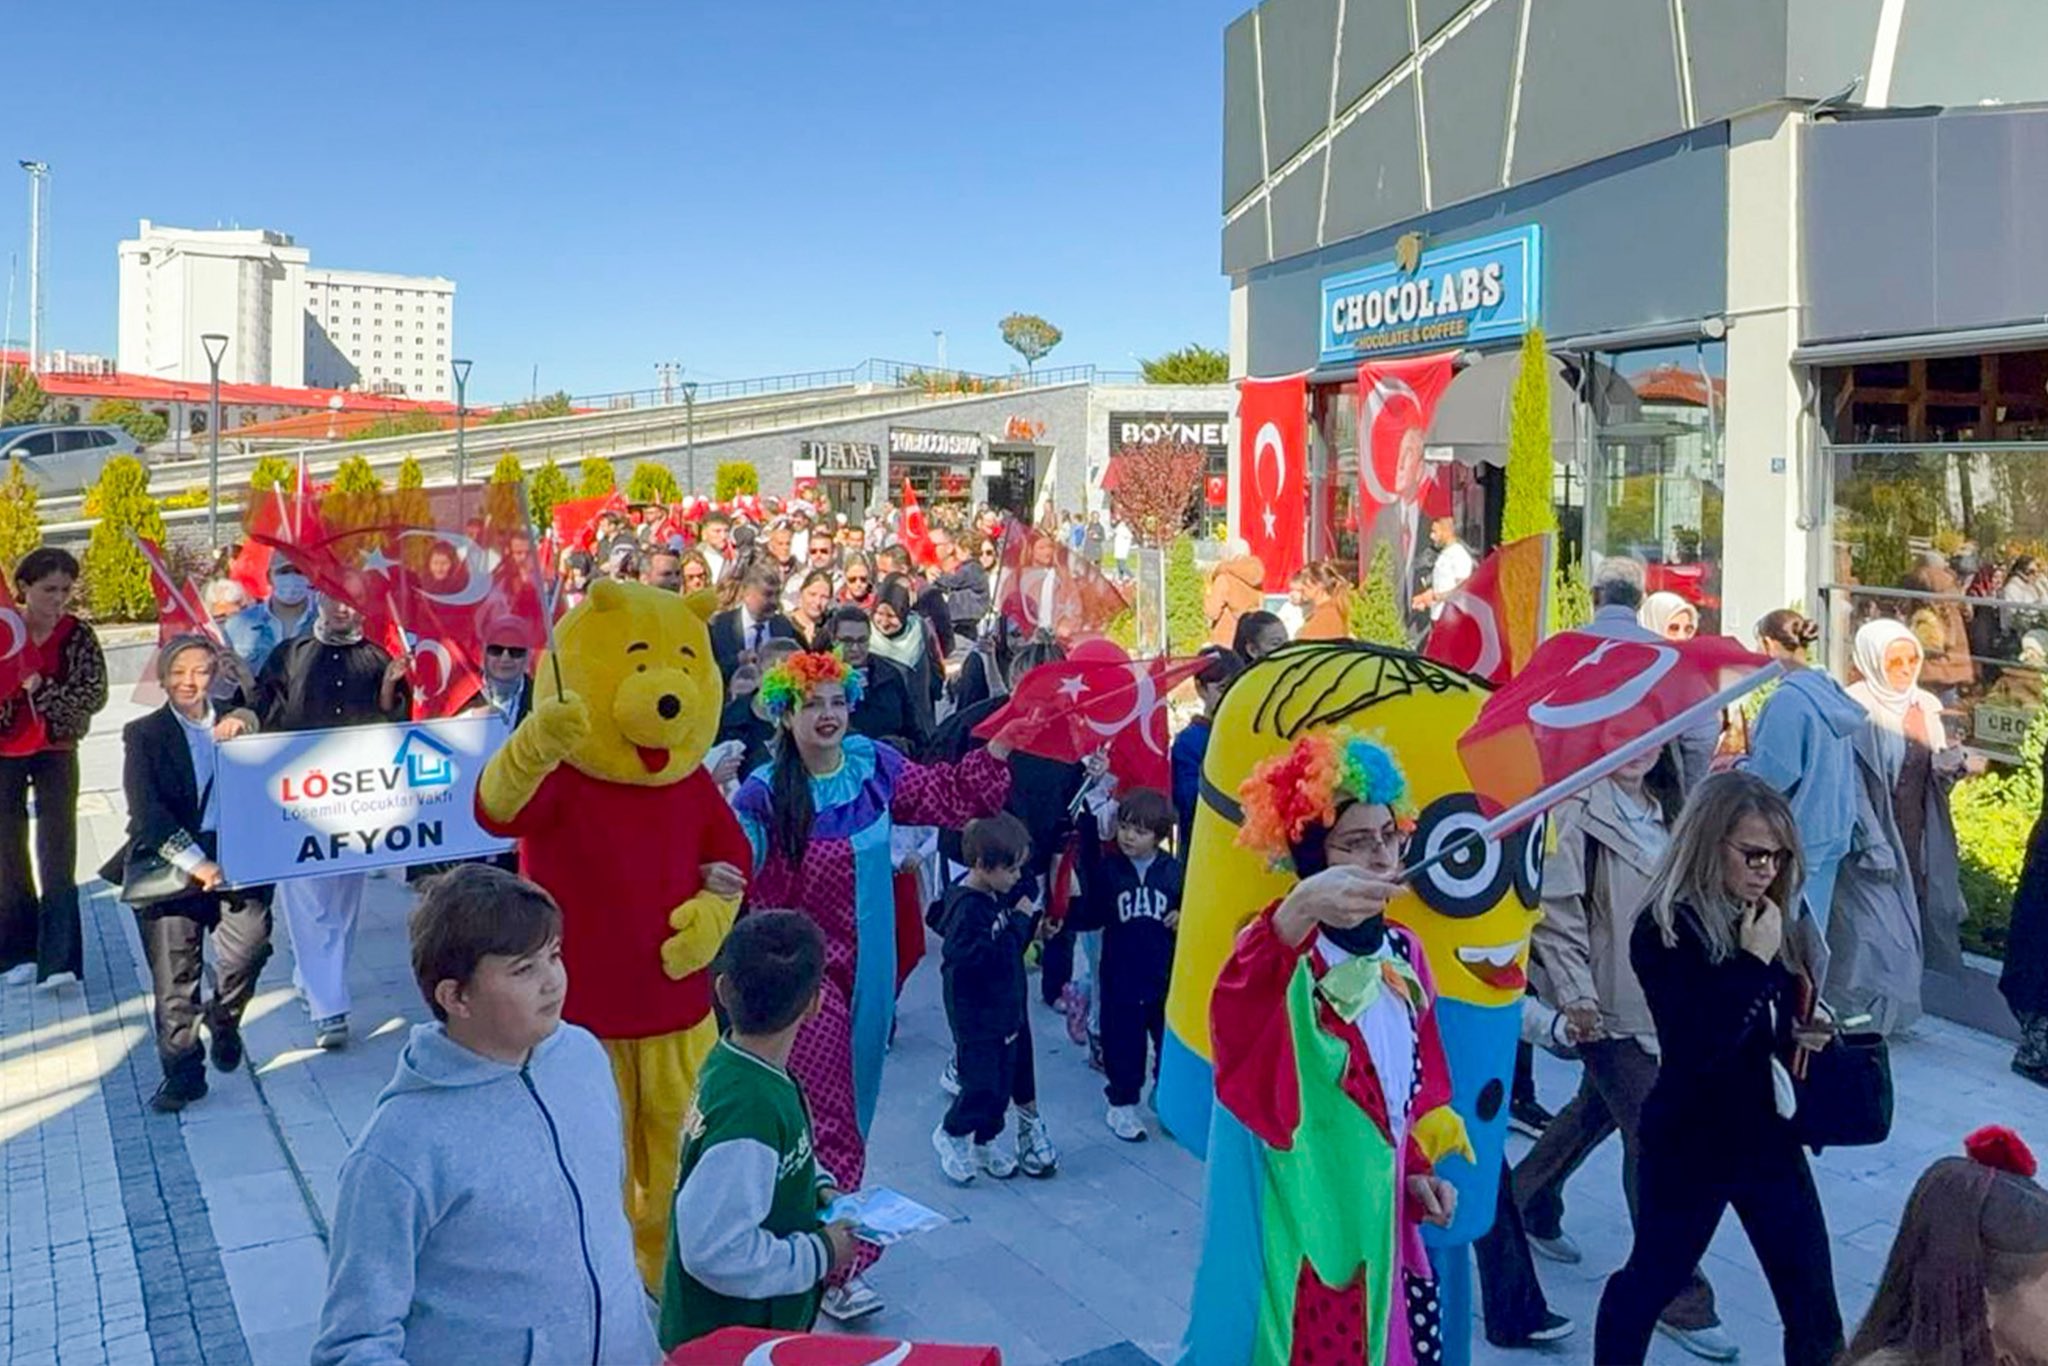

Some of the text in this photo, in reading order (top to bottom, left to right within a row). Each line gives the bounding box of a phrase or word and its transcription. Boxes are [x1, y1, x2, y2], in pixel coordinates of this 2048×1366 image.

[1331, 262, 1501, 334] CHOCOLABS
[1421, 319, 1466, 341] COFFEE
[281, 767, 402, 803] LÖSEV
[282, 789, 453, 822] Lösemili Çocuklar Vakfı
[296, 820, 443, 864] AFYON
[1117, 886, 1168, 923] GAP
